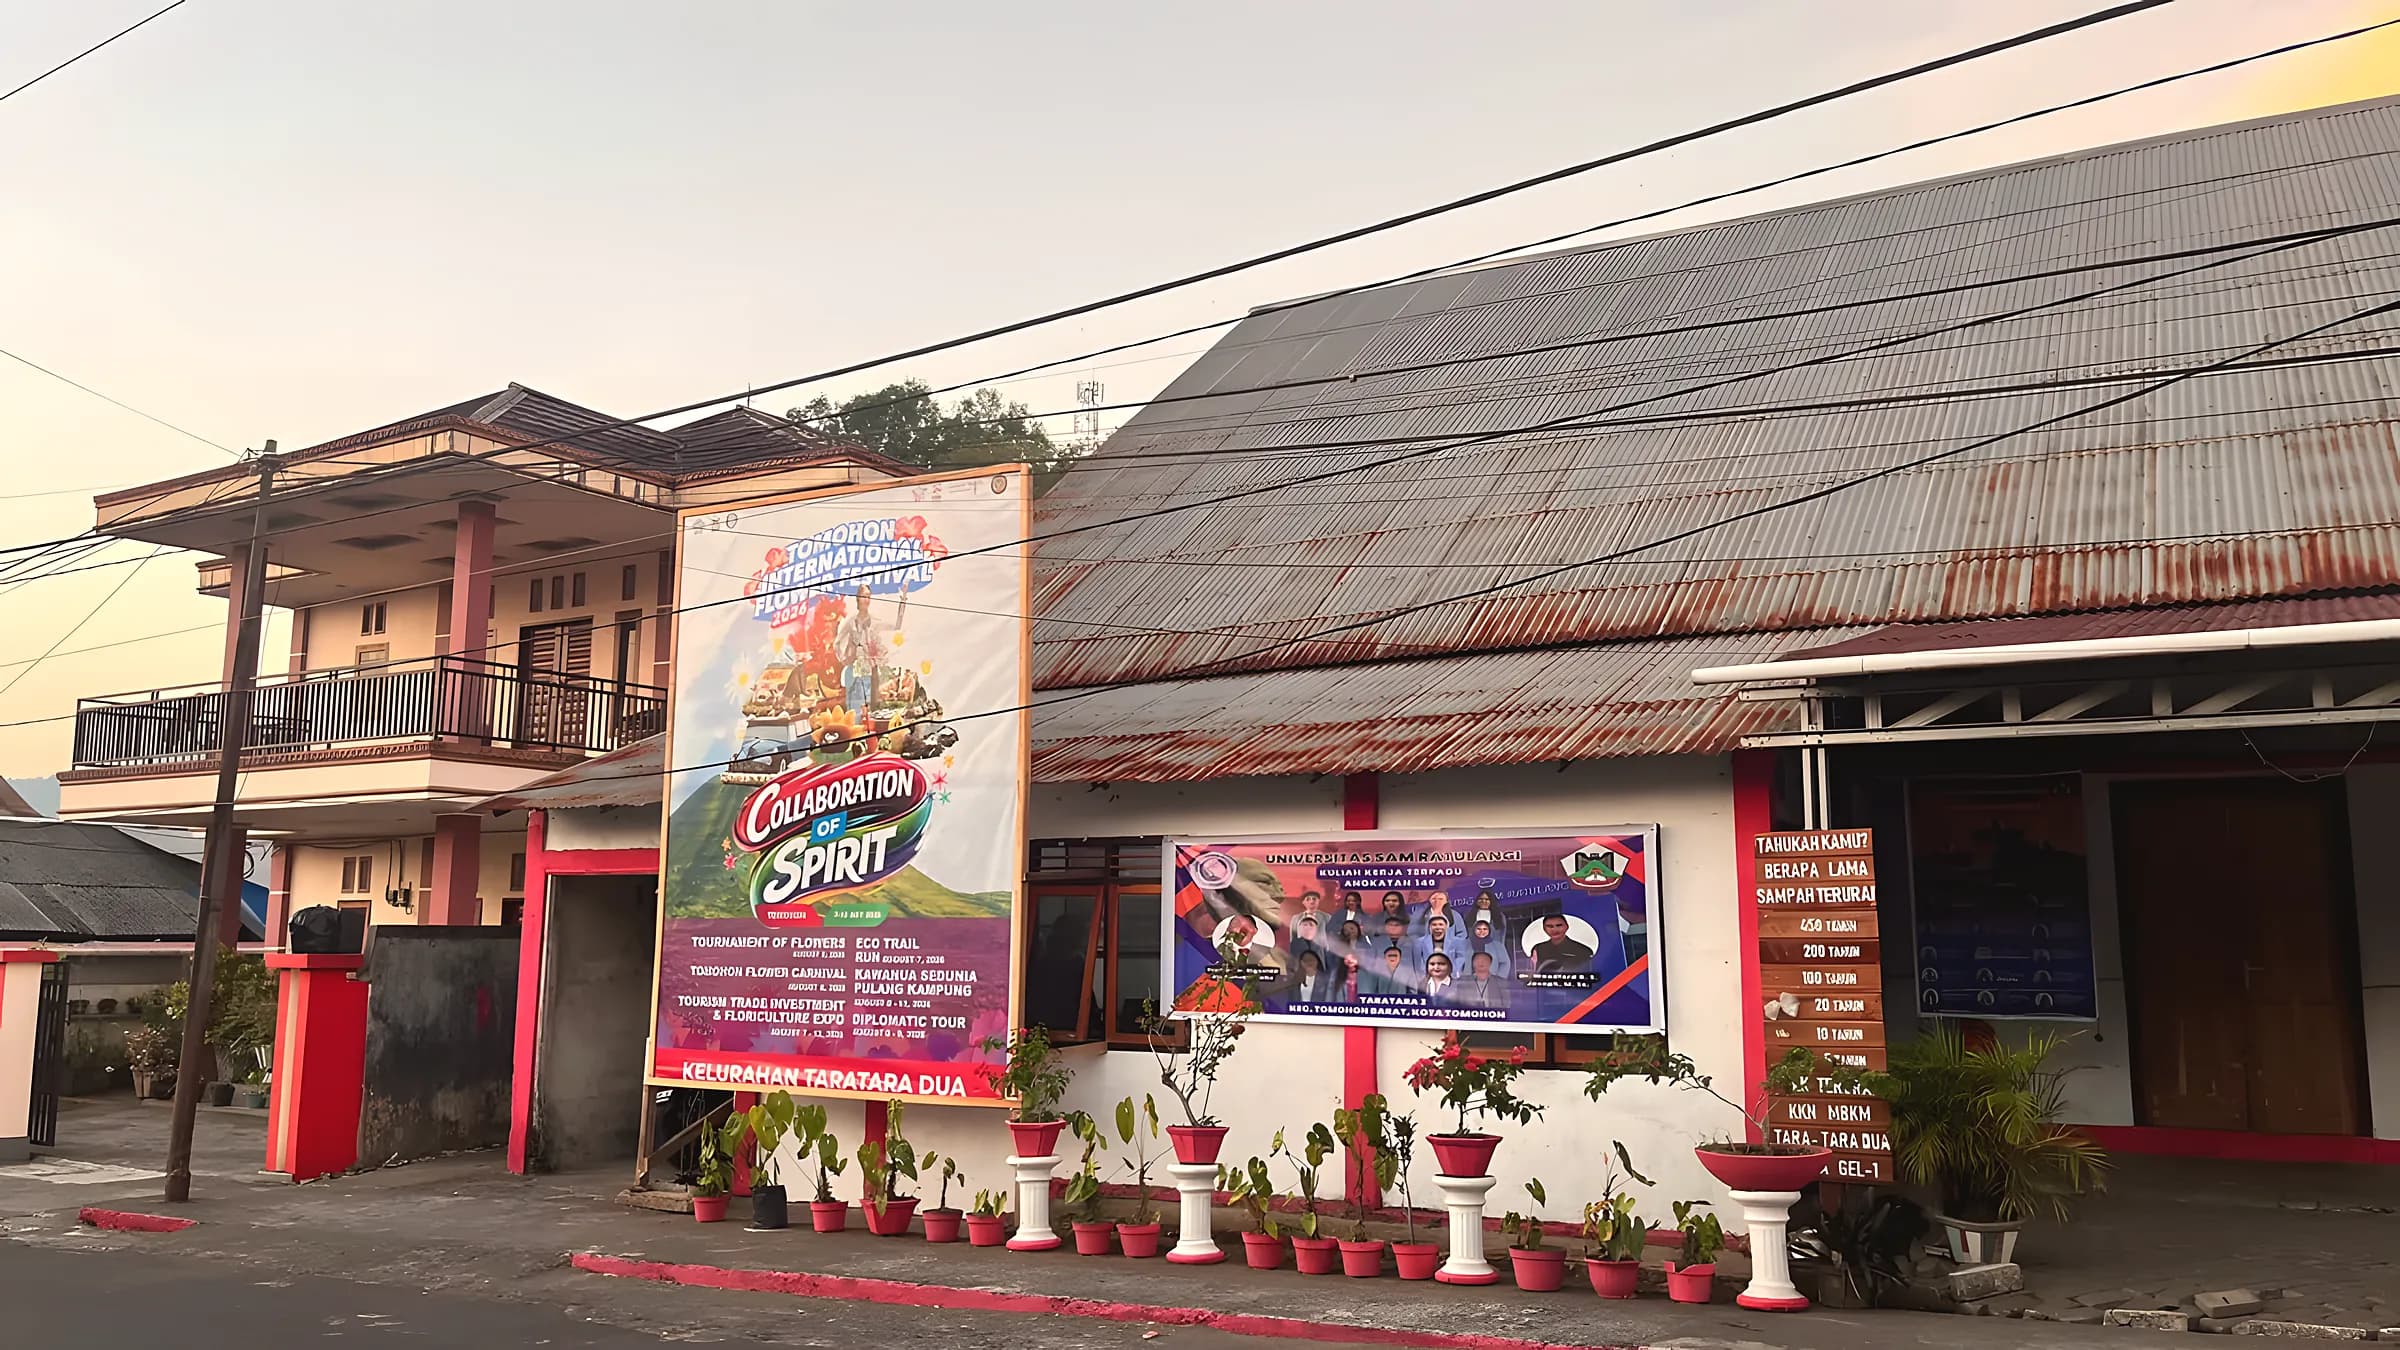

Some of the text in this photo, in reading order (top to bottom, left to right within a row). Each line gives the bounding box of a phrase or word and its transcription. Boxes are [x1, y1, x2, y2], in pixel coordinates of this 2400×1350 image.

[787, 519, 897, 563] TOMOHON
[758, 538, 926, 592] INTERNATIONAL
[754, 553, 935, 617] FLOWER FESTIVAL
[771, 602, 808, 626] 2026
[746, 769, 917, 843] COLLABORATION
[816, 817, 841, 837] OF
[1756, 832, 1868, 854] TAHUKAH KAMU?
[763, 825, 899, 904] SPIRIT
[1266, 850, 1522, 864] UNIVERSITAS SAM RATULANGI
[1319, 869, 1361, 877] KULIAH
[1764, 860, 1869, 879] BERAPA LAMA
[1756, 885, 1876, 904] SAMPAH TERURAI
[691, 936, 846, 949] TOURNAMENT OF FLOWERS
[855, 937, 920, 950] ECO TRAIL
[1803, 944, 1826, 958] 200
[855, 951, 880, 963] RUN
[690, 965, 847, 979] TOMOHON FLOWER CARNIVAL
[854, 968, 978, 983] KAWANUA SEDUNIA
[1802, 970, 1822, 985] 100
[854, 982, 972, 997] PULANG KAMPUNG
[677, 995, 846, 1012] TOURISM TRADE INVESTMENT
[1814, 997, 1830, 1012] 20
[712, 1009, 845, 1026] & FLORICULTURE EXPO
[852, 1013, 967, 1029] DIPLOMATIC TOUR
[1816, 1026, 1829, 1041] 10
[682, 1061, 968, 1097] KELURAHAN TARATARA DUA
[1788, 1103, 1871, 1121] KKN MBKM
[1861, 1132, 1891, 1151] DUA
[1838, 1159, 1879, 1179] GEL-1
